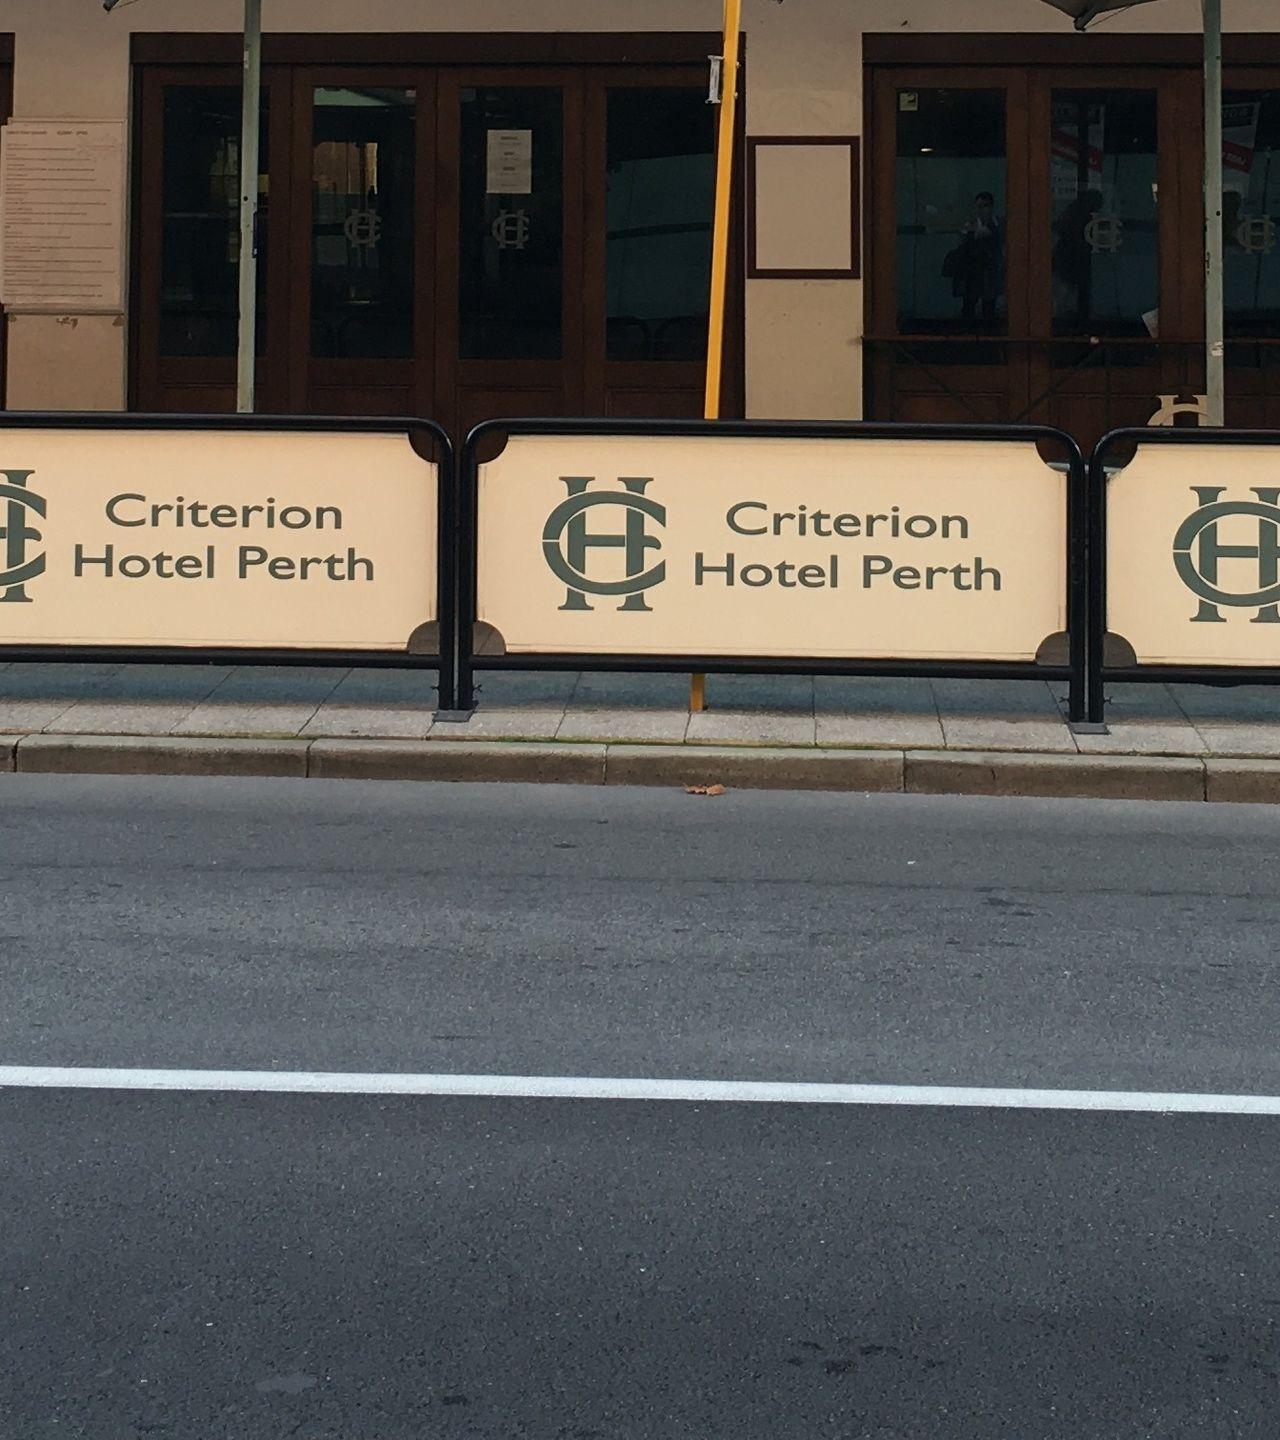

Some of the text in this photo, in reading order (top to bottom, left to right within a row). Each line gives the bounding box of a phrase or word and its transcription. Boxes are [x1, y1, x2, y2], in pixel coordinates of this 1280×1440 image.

[105, 492, 342, 529] Criterion
[725, 501, 969, 538] Criterion
[74, 544, 374, 580] Hotel Perth
[694, 552, 1002, 591] Hotel Perth
